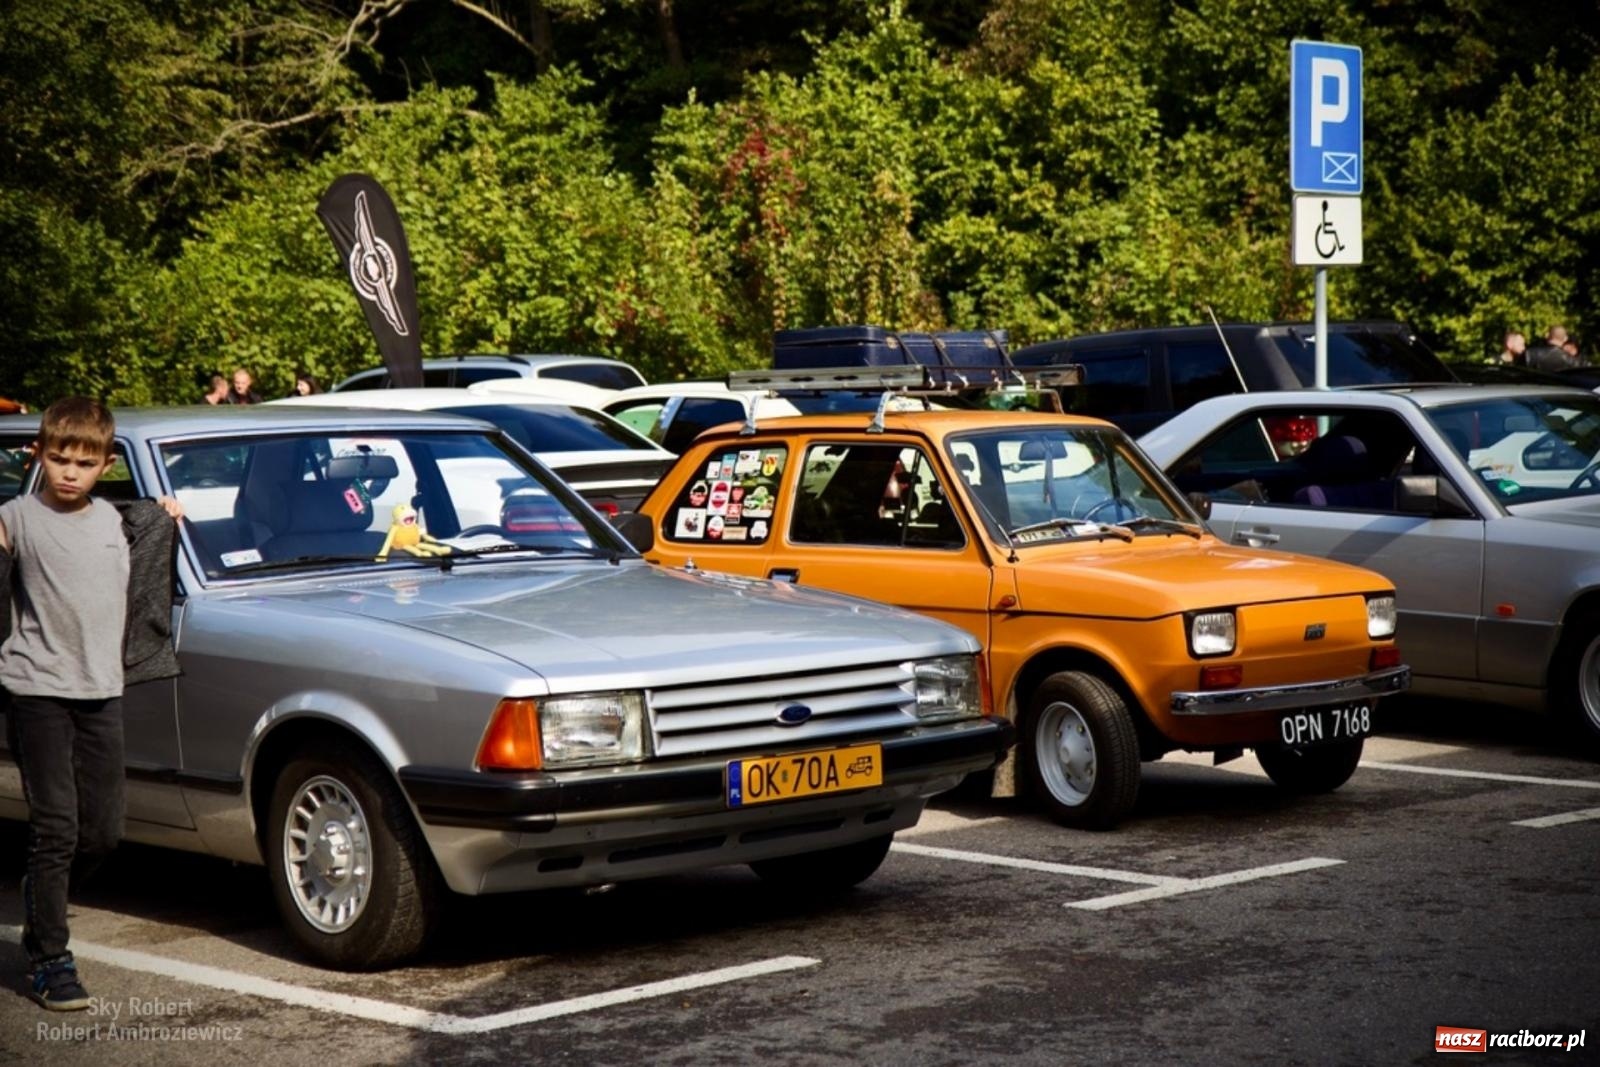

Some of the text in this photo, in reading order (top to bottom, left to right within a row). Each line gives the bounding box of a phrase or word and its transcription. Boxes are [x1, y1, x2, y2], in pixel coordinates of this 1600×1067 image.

[1310, 56, 1350, 147] P
[1281, 706, 1370, 744] OPN 7168
[747, 753, 840, 798] OK 70A
